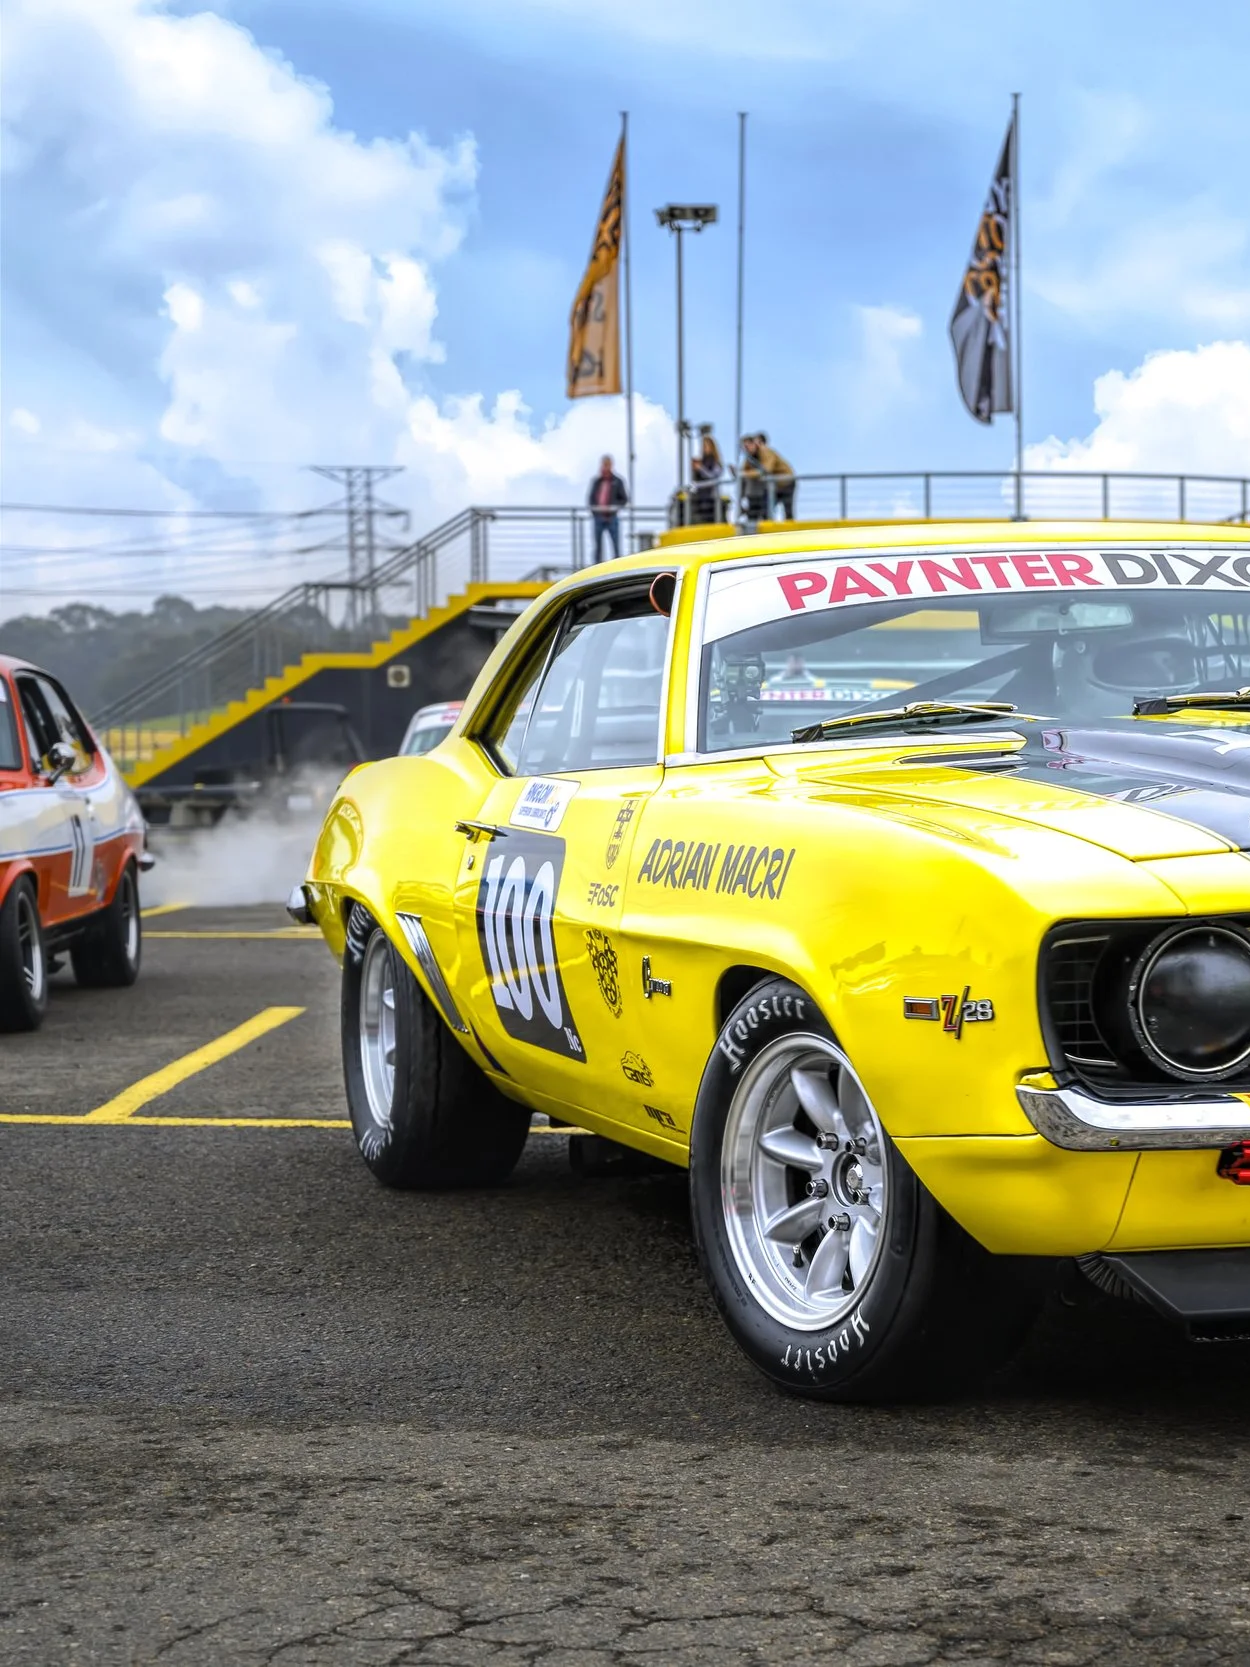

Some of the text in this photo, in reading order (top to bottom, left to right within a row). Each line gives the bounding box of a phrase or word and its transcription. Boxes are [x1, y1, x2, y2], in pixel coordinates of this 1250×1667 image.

[777, 553, 1104, 611] PAYNTER
[637, 838, 721, 891] ADRIAN
[715, 844, 797, 900] MACRI
[484, 855, 563, 1030] 100
[940, 985, 995, 1040] Z/28
